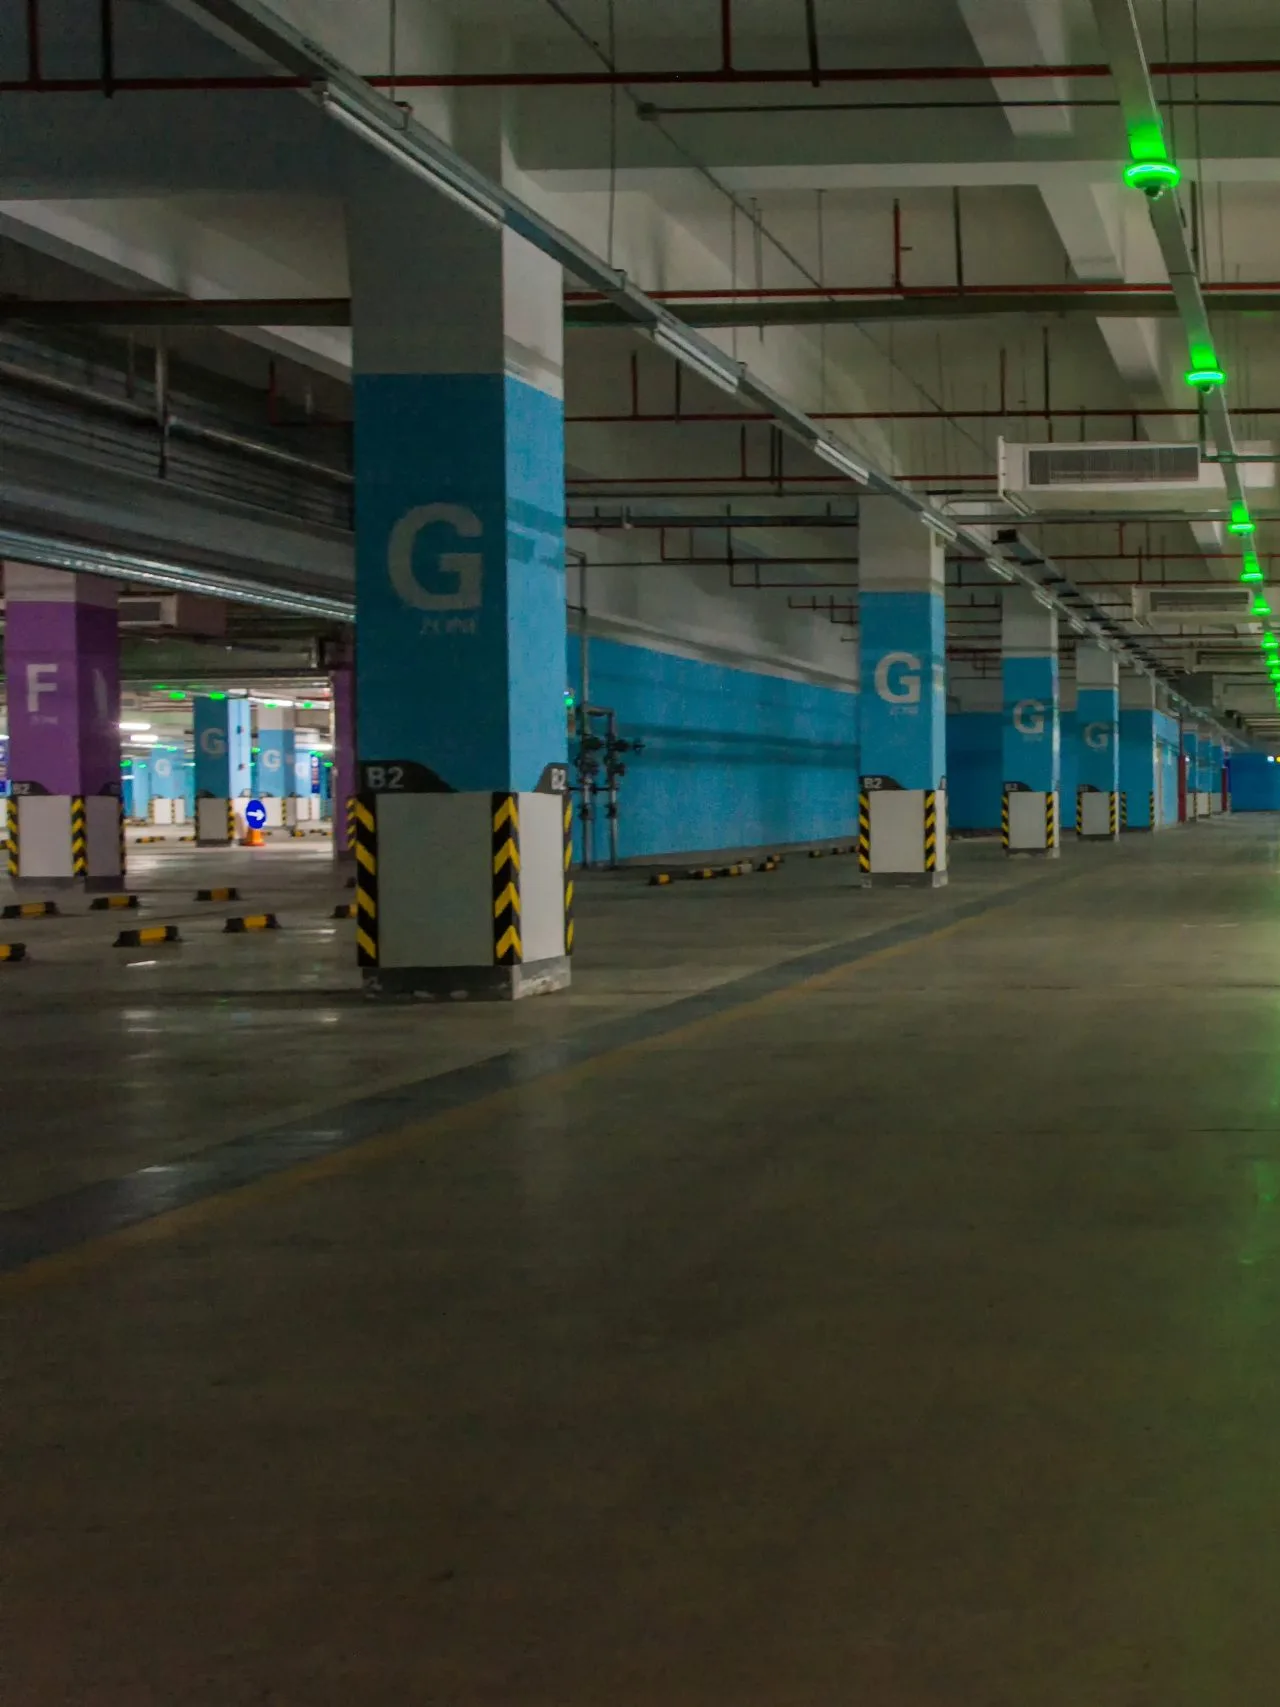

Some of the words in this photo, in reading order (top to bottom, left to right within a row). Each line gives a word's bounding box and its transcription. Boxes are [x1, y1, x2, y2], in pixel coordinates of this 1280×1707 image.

[388, 502, 482, 610] G
[27, 664, 57, 712] F
[874, 651, 920, 703] G
[1013, 699, 1044, 733] G
[201, 728, 225, 754] G
[1085, 722, 1109, 748] G
[263, 749, 281, 769] G
[367, 767, 404, 788] B2
[551, 769, 565, 790] B2
[863, 778, 882, 789] B2
